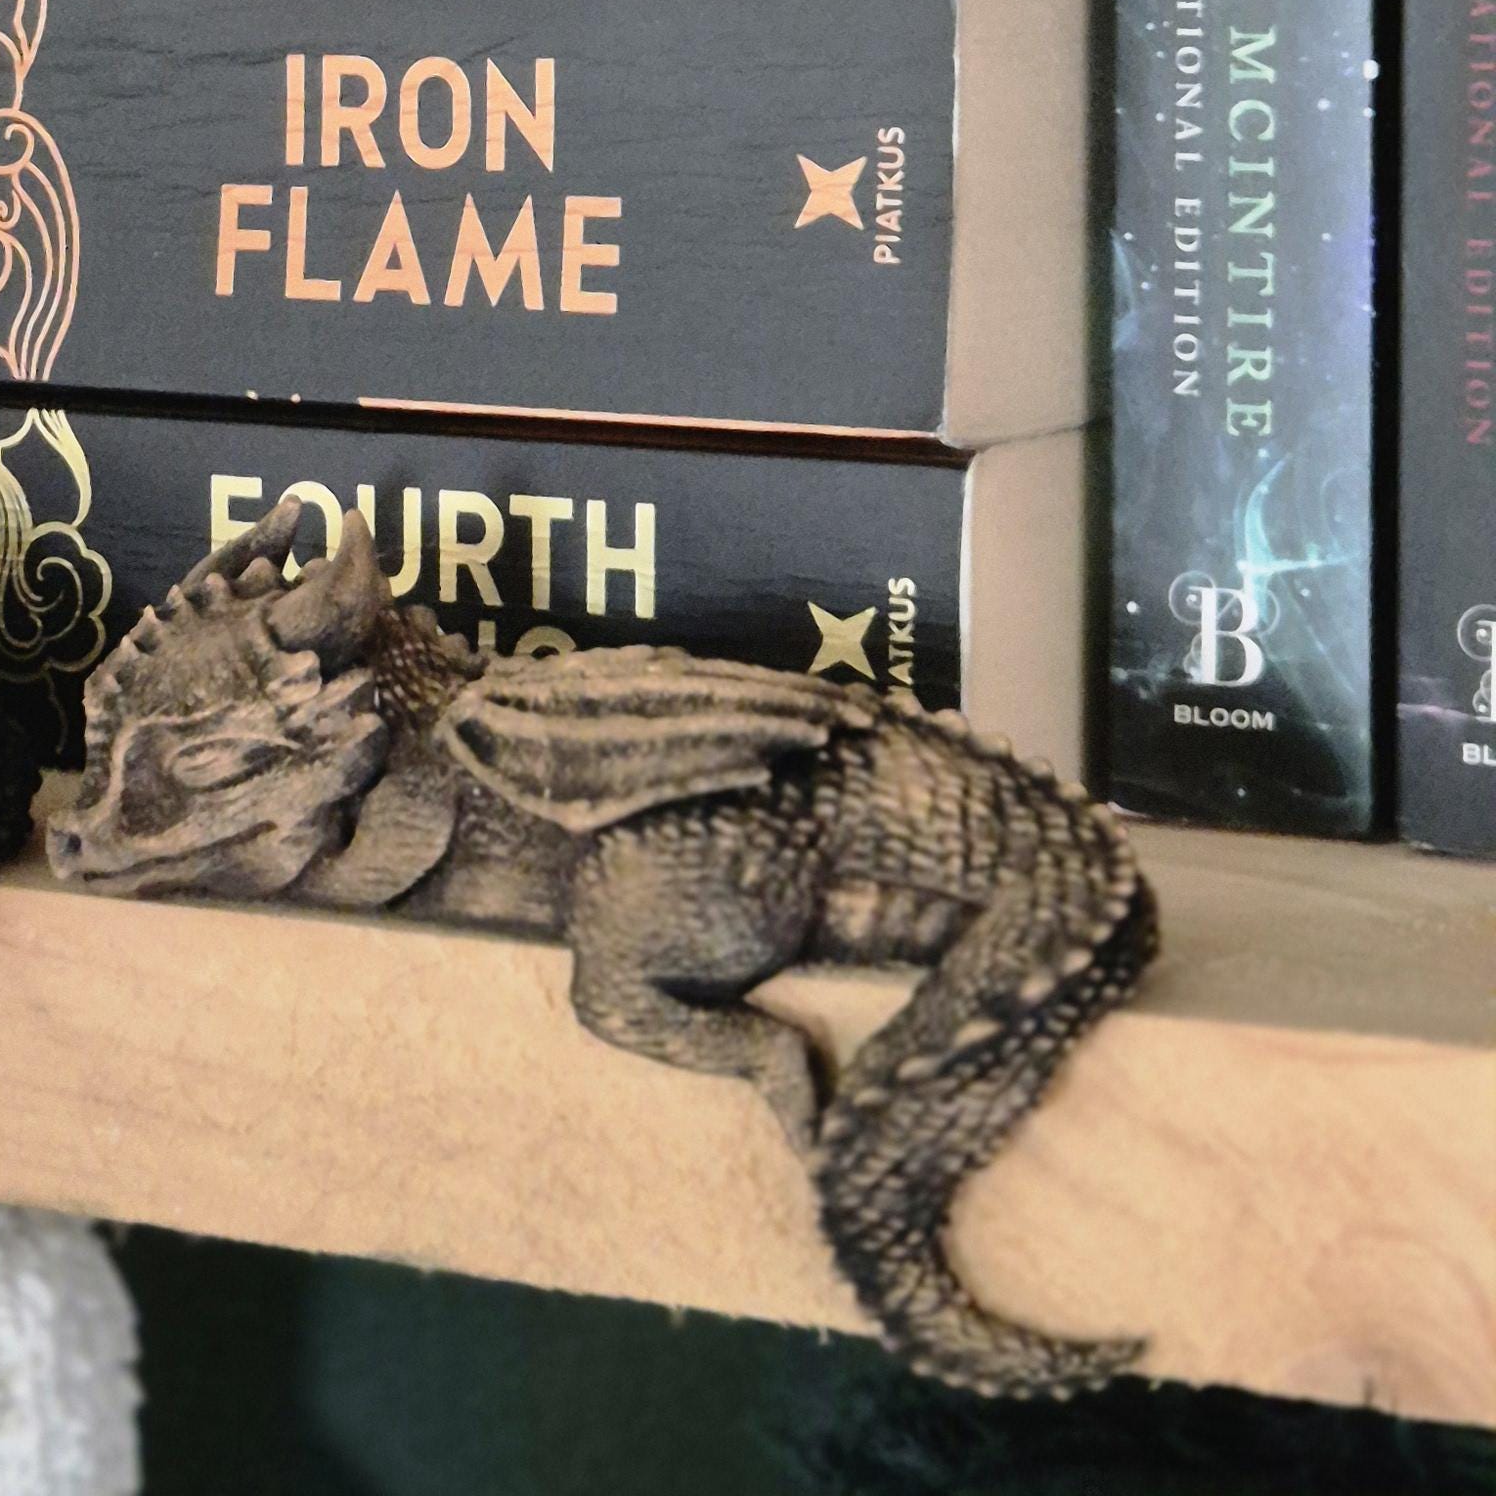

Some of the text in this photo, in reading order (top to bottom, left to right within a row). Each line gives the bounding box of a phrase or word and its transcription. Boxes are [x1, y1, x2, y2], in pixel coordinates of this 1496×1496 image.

[284, 53, 557, 173] IRON
[214, 183, 623, 315] FLAME
[873, 125, 906, 266] PIATKUS
[1224, 25, 1278, 438] MCINTIRE
[1173, 196, 1203, 398] EDITION
[1463, 237, 1495, 446] EDITION
[209, 473, 657, 620] FOURTH
[887, 575, 917, 696] IATKUS
[1173, 704, 1275, 731] BLOOM
